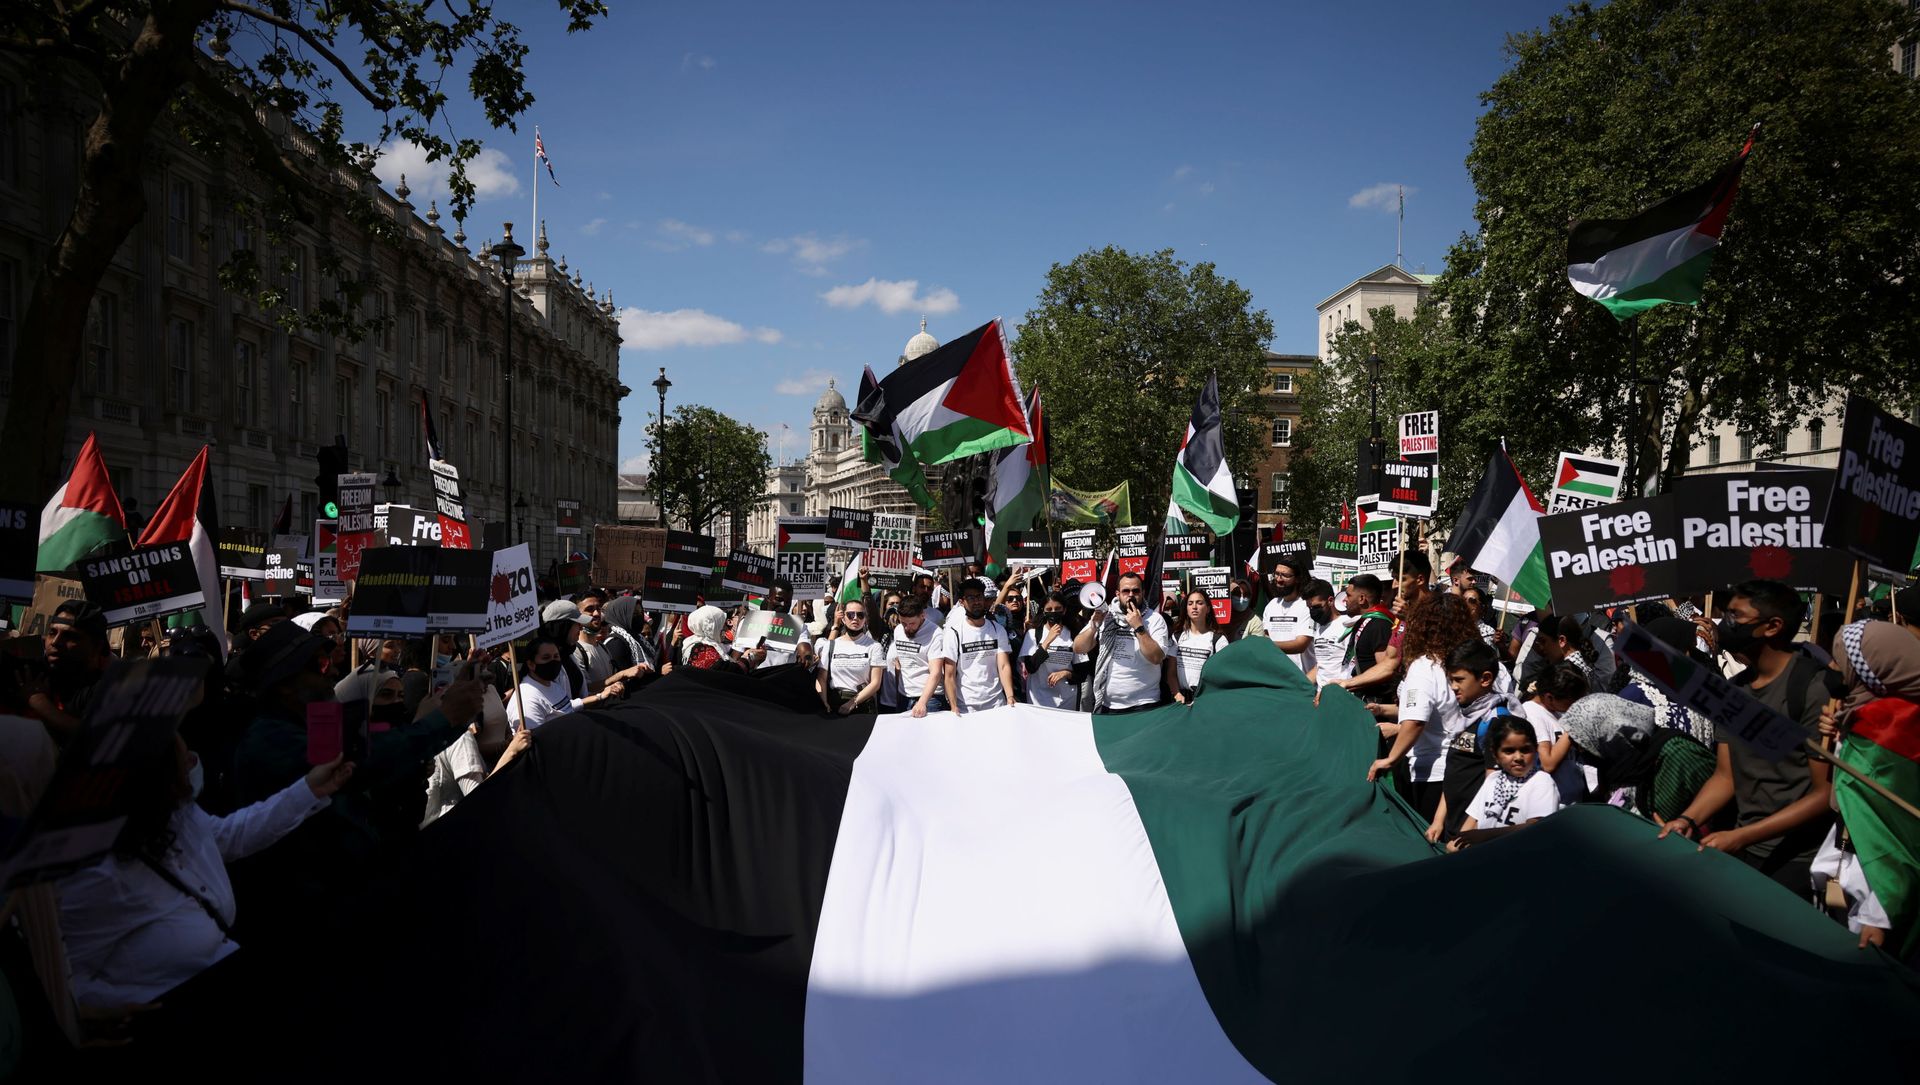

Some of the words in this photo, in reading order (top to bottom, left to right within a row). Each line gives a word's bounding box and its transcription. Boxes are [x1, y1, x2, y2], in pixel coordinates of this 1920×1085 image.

[1405, 413, 1434, 436] FREE
[1401, 436, 1437, 452] PALESTINE
[1867, 415, 1905, 470] Free
[1385, 464, 1428, 478] SANCTIONS
[1400, 477, 1411, 488] ON
[1839, 449, 1920, 521] Palestine
[340, 488, 372, 506] FREEDOM
[1392, 488, 1418, 501] ISRAEL
[1727, 479, 1811, 513] Free
[832, 509, 870, 522] SANCTIONS
[339, 513, 372, 532] PALESTINE
[844, 521, 854, 529] ON
[881, 516, 912, 529] PALESTINE
[1581, 511, 1652, 542] Free
[941, 541, 952, 550] ON
[1065, 537, 1092, 548] FREEDOM
[1120, 534, 1145, 544] FREEDOM
[1165, 536, 1206, 545] SANCTIONS
[1339, 535, 1358, 544] FREE
[1360, 530, 1397, 554] FREE
[1120, 547, 1147, 556] PALESTINE
[1181, 544, 1191, 552] ON
[1266, 542, 1306, 555] SANCTIONS
[733, 553, 776, 569] SANCTIONS
[862, 550, 909, 570] RETURN!
[1063, 550, 1094, 560] PALESTINE
[1173, 552, 1199, 560] ISRAEL
[1550, 535, 1677, 579] Palestin
[86, 546, 182, 578] SANCTIONS
[777, 553, 826, 573] FREE
[127, 568, 151, 585] ON
[747, 565, 758, 575] ON
[1196, 575, 1226, 586] FREEDOM
[494, 614, 513, 630] the
[514, 605, 534, 623] siege
